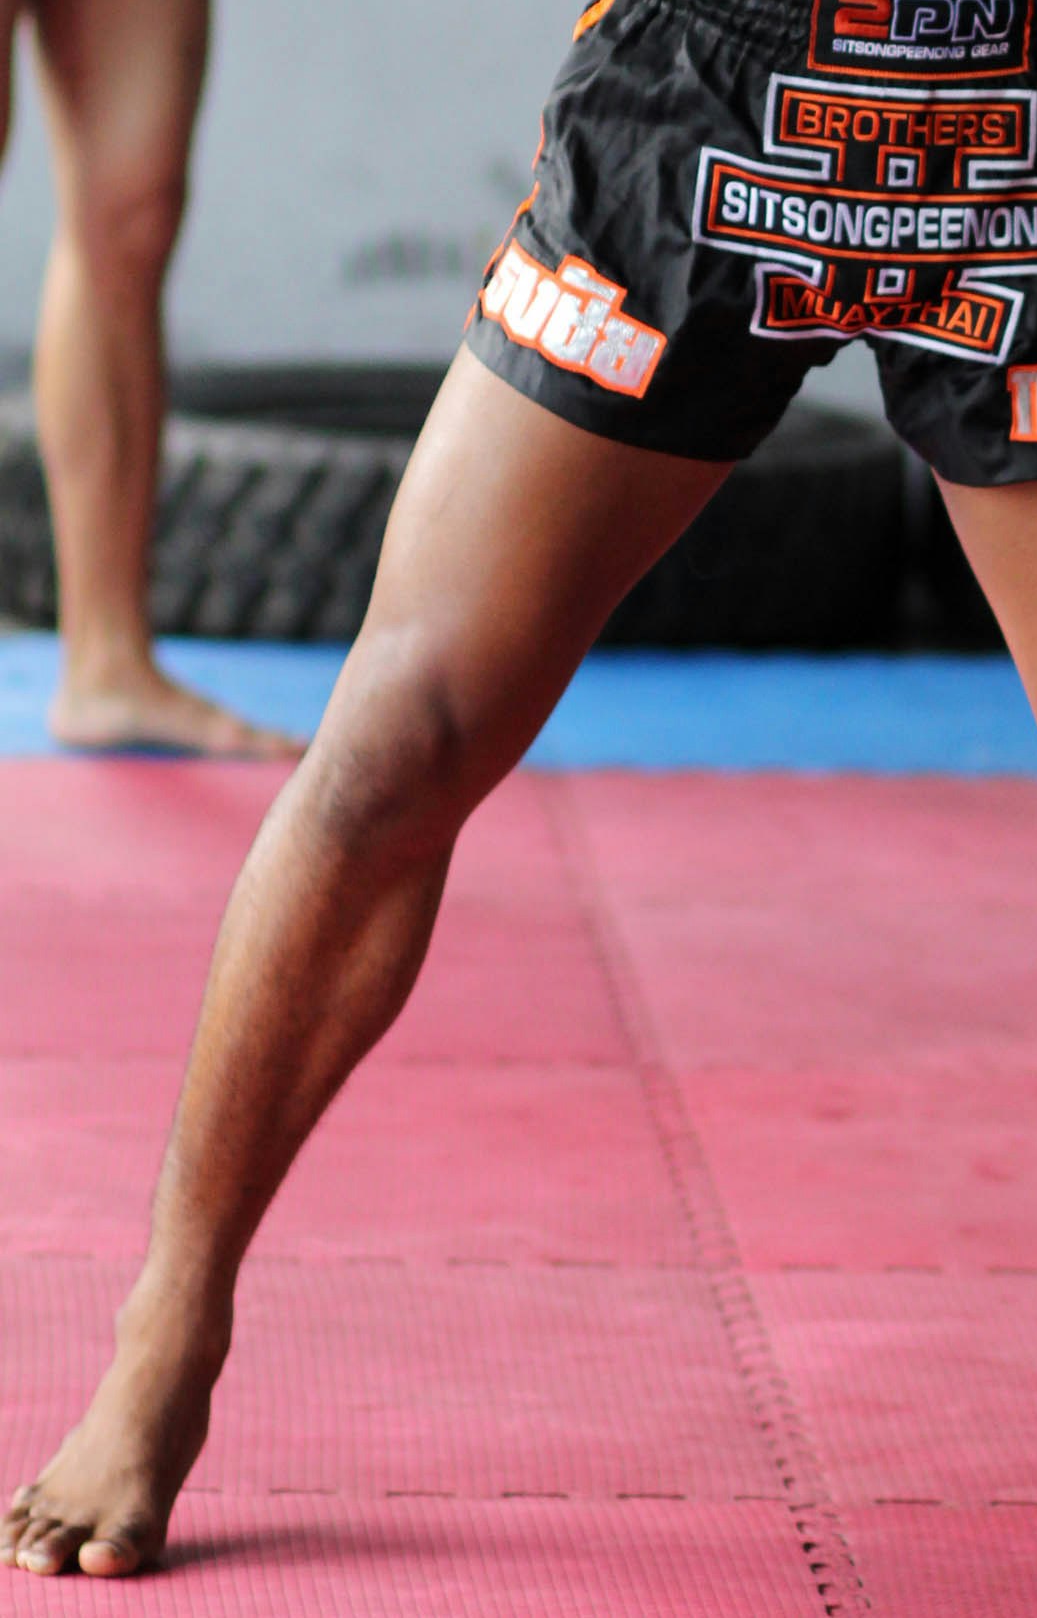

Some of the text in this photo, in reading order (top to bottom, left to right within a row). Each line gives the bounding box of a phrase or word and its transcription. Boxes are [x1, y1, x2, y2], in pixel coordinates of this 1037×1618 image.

[832, 38, 1009, 60] SITSONGPEENONG GEAR
[796, 103, 1008, 145] BROTHERS
